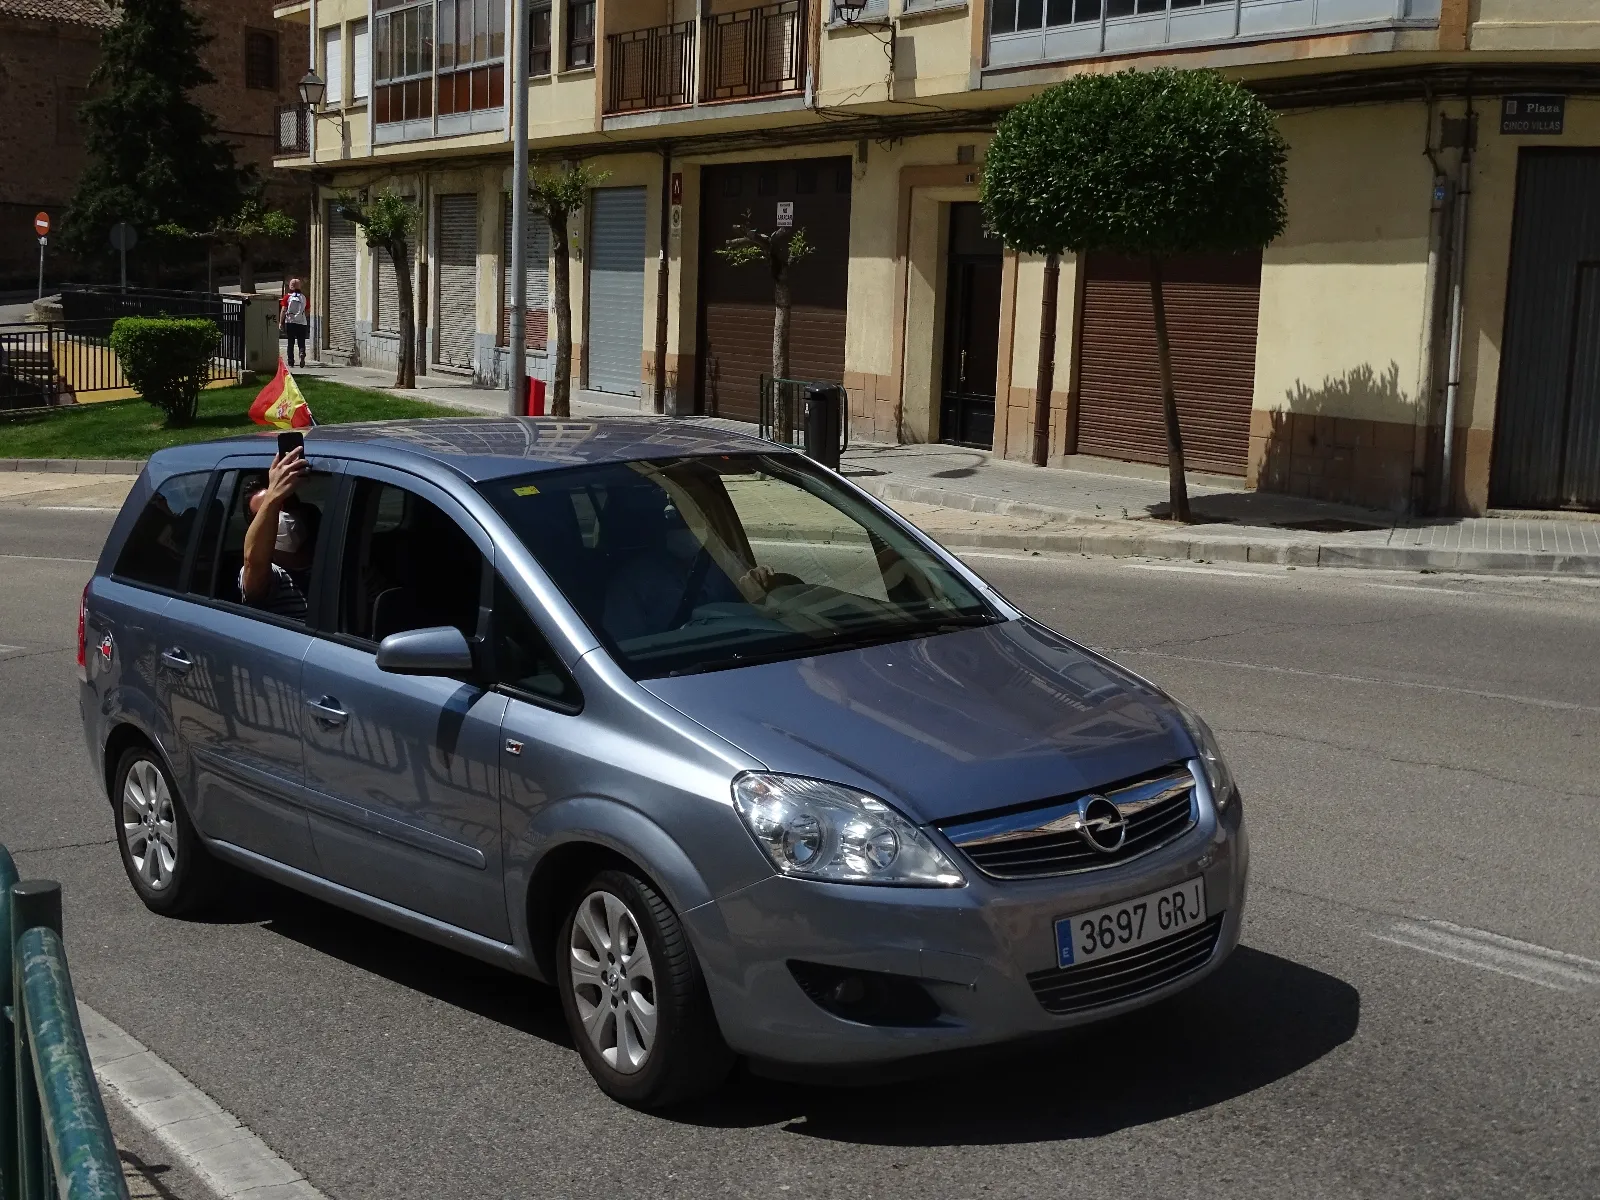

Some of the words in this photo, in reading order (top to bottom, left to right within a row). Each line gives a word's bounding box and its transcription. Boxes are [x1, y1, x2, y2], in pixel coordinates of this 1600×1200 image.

[1526, 103, 1560, 113] Plaza
[1503, 121, 1529, 130] CINCO
[1531, 121, 1560, 130] VILLAS
[1079, 902, 1148, 955] 3697
[1157, 885, 1200, 930] GRJ
[1062, 948, 1070, 958] E
